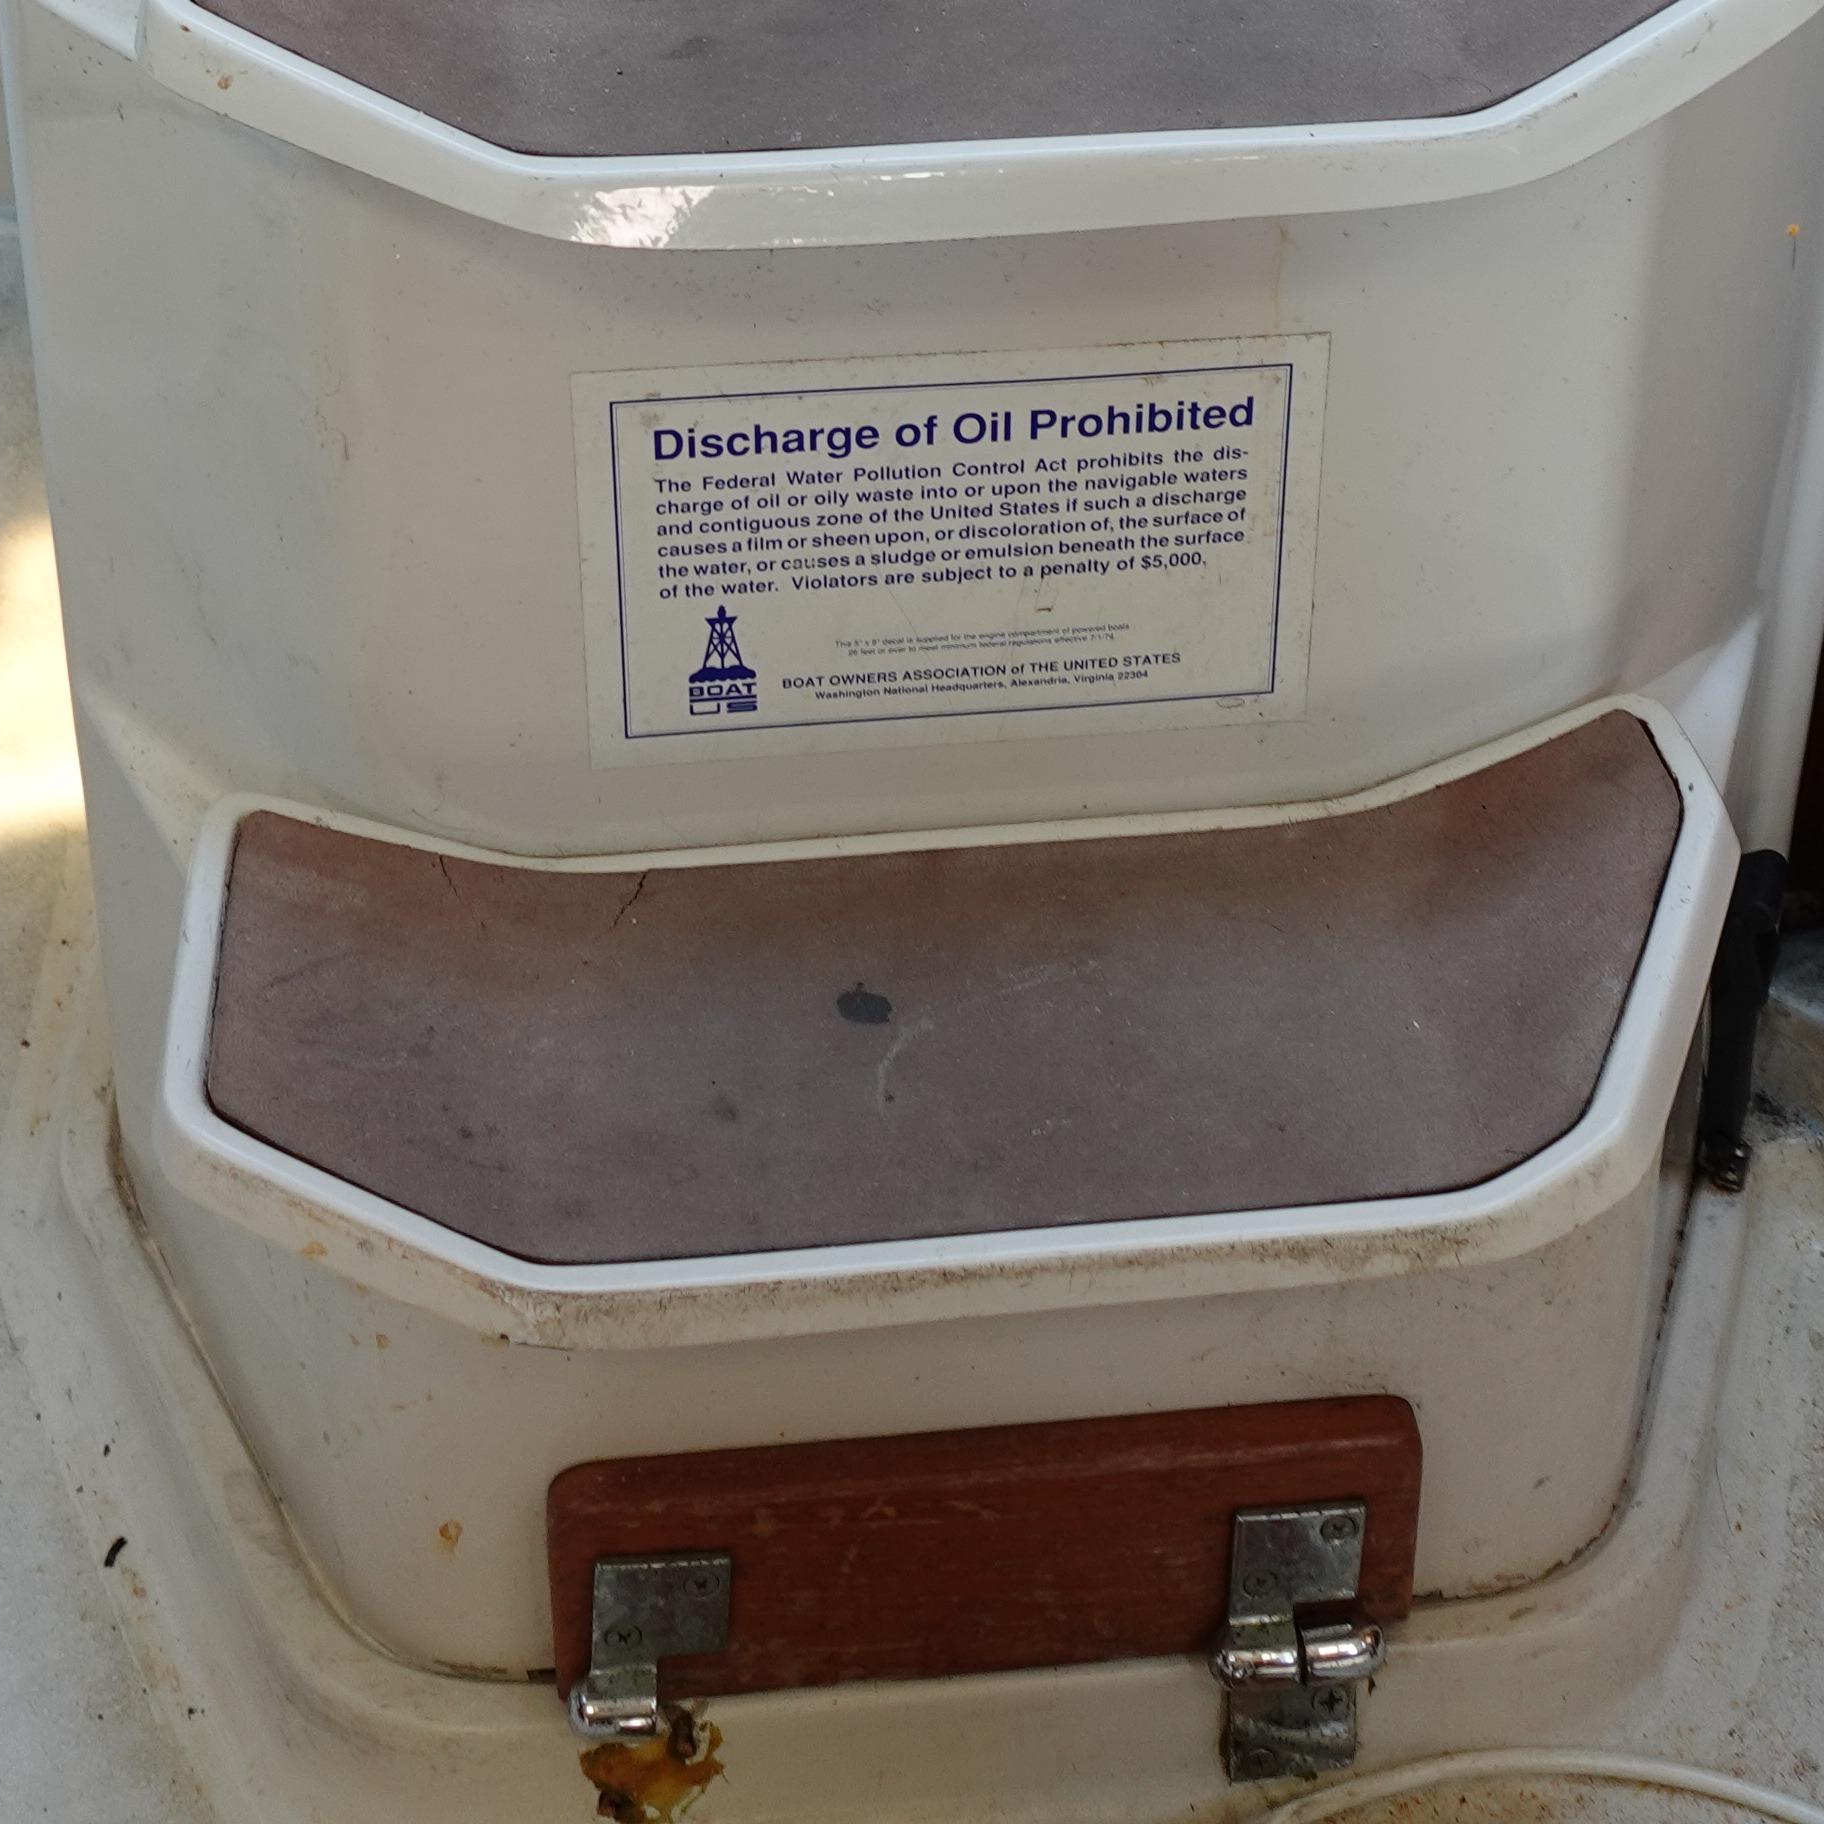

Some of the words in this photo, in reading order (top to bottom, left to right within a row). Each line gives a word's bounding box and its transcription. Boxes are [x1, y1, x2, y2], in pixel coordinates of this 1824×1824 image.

[654, 424, 879, 460] Discharge
[896, 415, 938, 447] of
[954, 412, 1011, 444] Oil
[1030, 396, 1254, 440] Prohibited
[654, 479, 691, 493] The
[703, 472, 775, 490] Federal
[786, 471, 842, 485] Water
[854, 465, 941, 482] Pollution
[952, 460, 1024, 476] Control
[1035, 458, 1066, 472] Act
[1078, 452, 1163, 473] prohibits
[1174, 450, 1203, 463] the
[1214, 446, 1248, 460] dis-
[656, 500, 723, 516] charge
[731, 496, 749, 510] of
[757, 494, 779, 508] oil
[788, 496, 807, 506] or
[814, 490, 849, 507] oily
[856, 488, 913, 502] waste
[922, 486, 957, 499] into
[965, 486, 984, 497] or
[992, 483, 1040, 498] upon
[1048, 478, 1077, 492] the
[1086, 471, 1177, 491] navigable
[1184, 468, 1247, 482] waters
[657, 520, 692, 536] and
[700, 516, 810, 534] contiguous
[817, 514, 862, 526] zone
[869, 509, 887, 523] of
[894, 508, 924, 522] the
[931, 504, 992, 520] United
[1000, 502, 1060, 516] States
[1067, 498, 1077, 512] if
[1084, 495, 1129, 511] such
[1136, 497, 1145, 508] a
[1152, 490, 1246, 506] discharge
[658, 543, 727, 557] causes
[732, 542, 742, 552] a
[748, 537, 782, 551] film
[788, 538, 807, 549] or
[812, 533, 870, 547] sheen
[935, 530, 954, 540] or
[959, 520, 1085, 539] discoloration
[1119, 516, 1148, 530] the
[1153, 511, 1223, 527] surface
[1228, 508, 1245, 521] of
[659, 564, 688, 578] the
[757, 561, 776, 571] or
[781, 556, 850, 570] causes
[856, 555, 865, 566] a
[871, 550, 936, 566] sludge
[941, 550, 960, 561] or
[965, 542, 1053, 560] emulsion
[1059, 536, 1134, 554] beneath
[1141, 535, 1169, 548] the
[1174, 530, 1244, 546] surface
[660, 585, 677, 599] of
[685, 584, 714, 597] the
[722, 580, 778, 594] water.
[792, 575, 878, 590] Violators
[885, 573, 914, 584] are
[922, 566, 992, 584] subject
[999, 566, 1016, 578] to
[1024, 566, 1033, 576] a
[1041, 560, 1109, 580] penalty
[1117, 556, 1134, 570] of
[689, 683, 757, 697] BOAT
[783, 676, 824, 688] BOAT
[830, 672, 897, 686] OWNERS
[903, 665, 1006, 681] ASSOCIATION
[1011, 664, 1024, 674] of
[1030, 662, 1058, 672] THE
[1064, 658, 1118, 671] UNITED
[1123, 653, 1180, 666] STATES
[815, 689, 880, 699] Washington
[884, 684, 928, 695] National
[1074, 673, 1114, 684] Virginia
[689, 701, 758, 716] US
